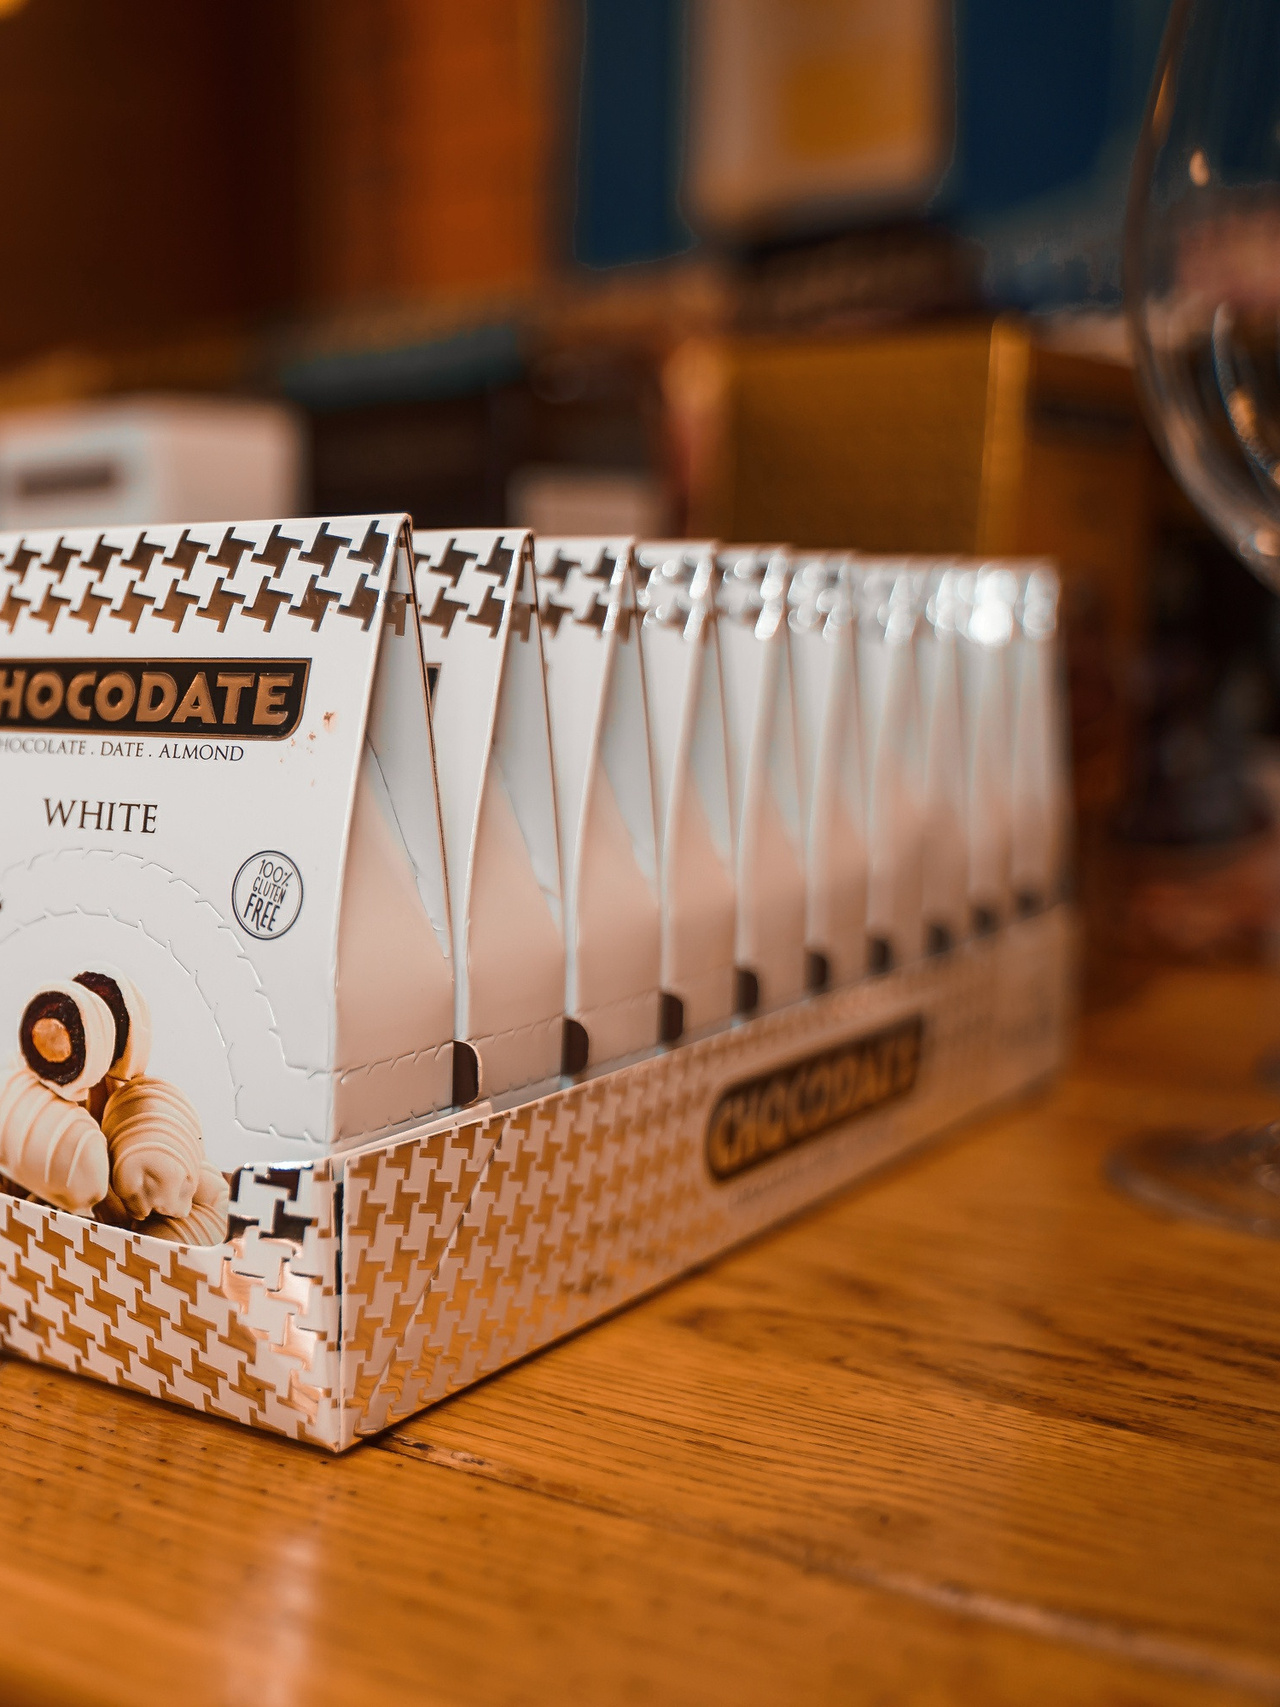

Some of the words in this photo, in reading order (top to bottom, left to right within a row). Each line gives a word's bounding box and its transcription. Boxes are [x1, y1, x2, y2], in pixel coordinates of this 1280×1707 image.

[100, 741, 144, 758] DATE
[158, 744, 244, 762] ALMOND
[43, 798, 157, 833] WHITE
[259, 859, 293, 887] 100%
[253, 876, 286, 904] GLUTEN
[243, 892, 280, 932] FREE
